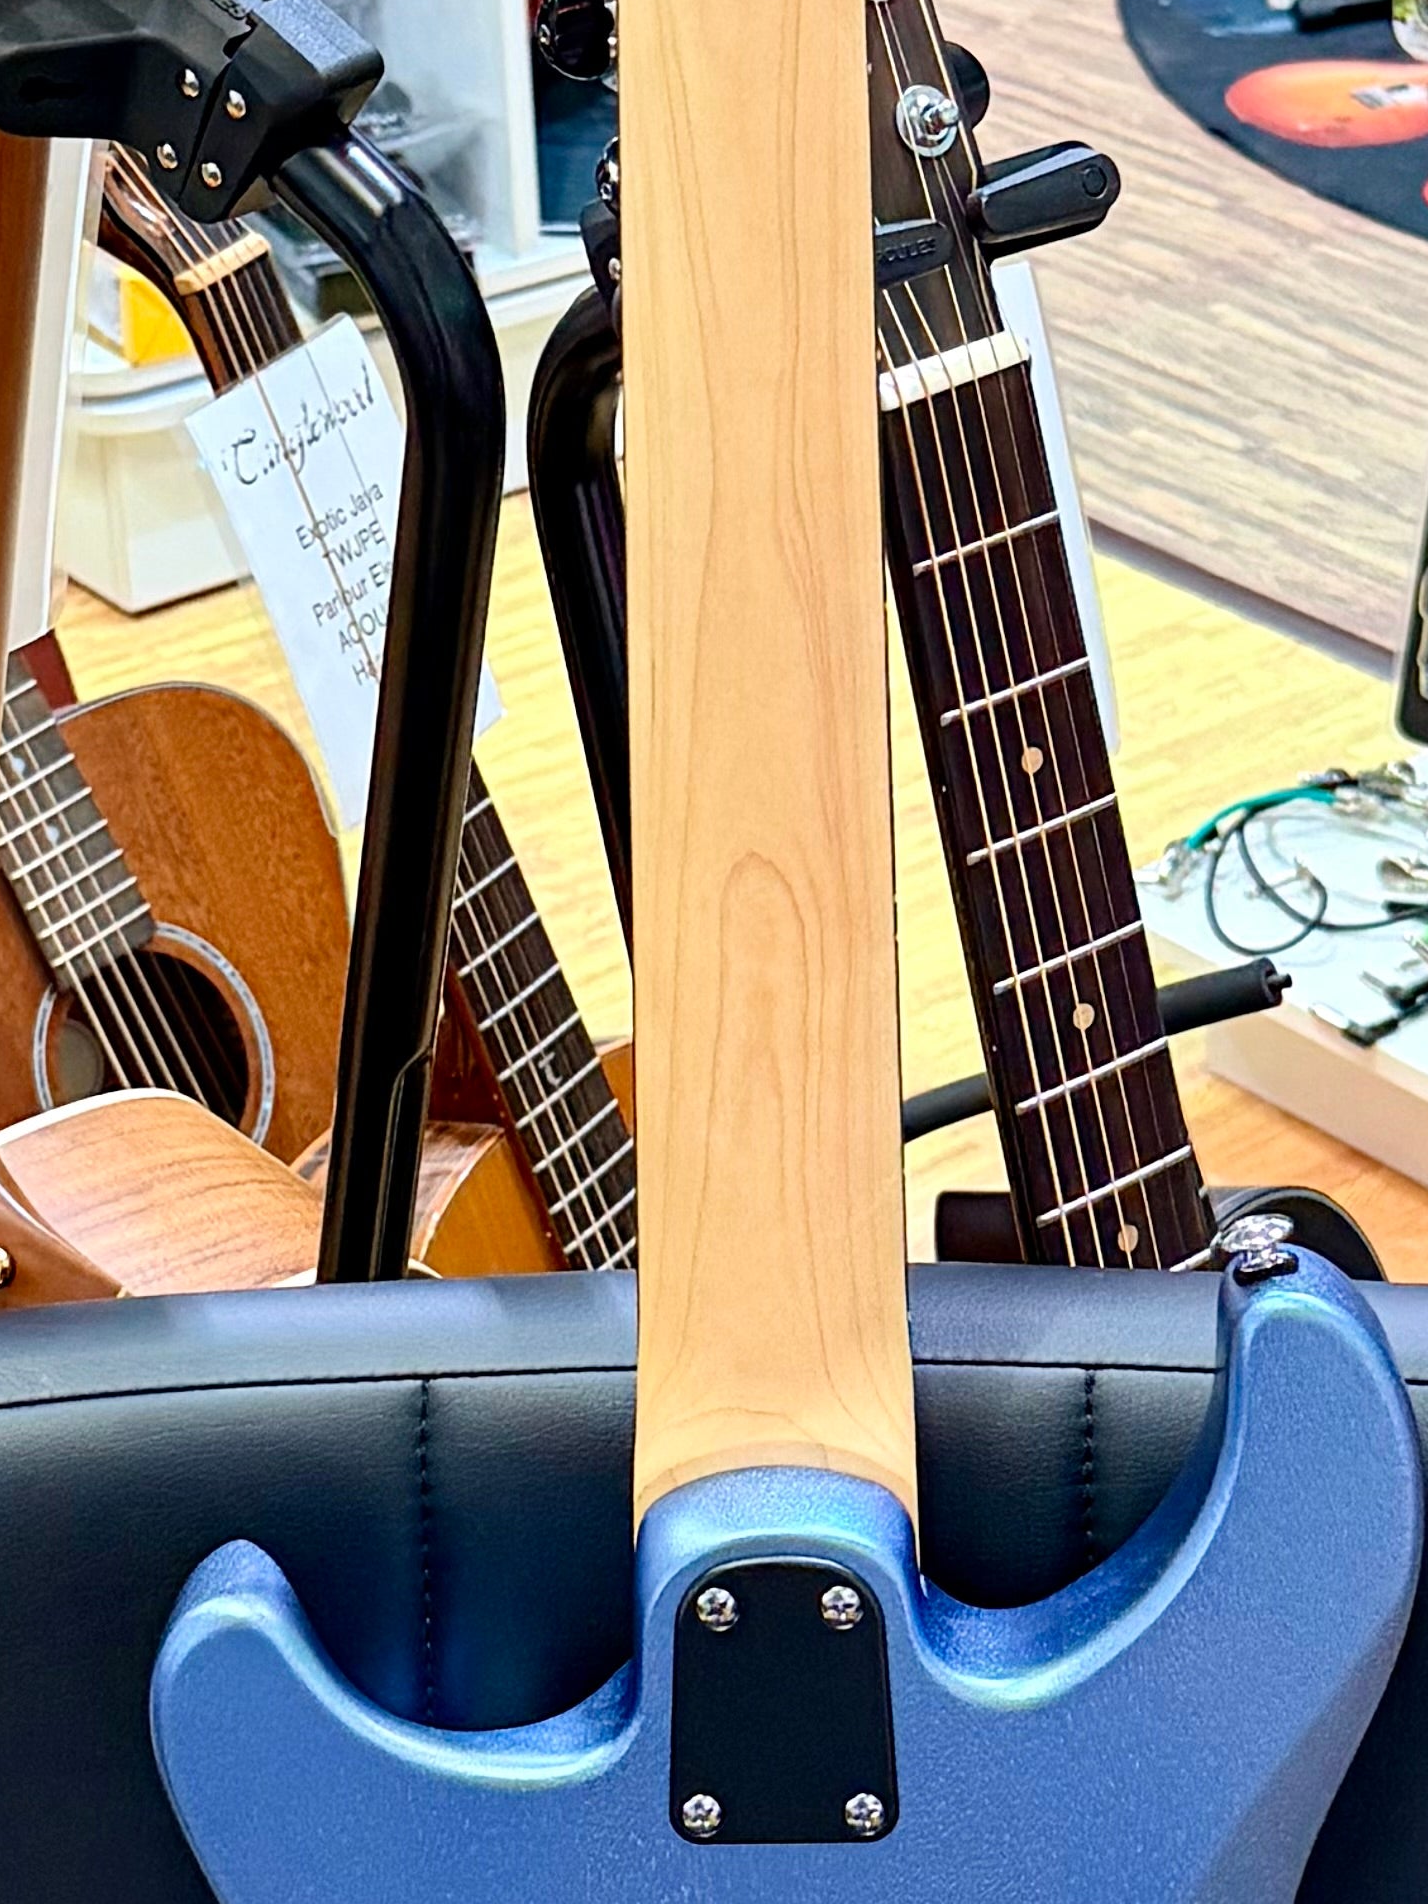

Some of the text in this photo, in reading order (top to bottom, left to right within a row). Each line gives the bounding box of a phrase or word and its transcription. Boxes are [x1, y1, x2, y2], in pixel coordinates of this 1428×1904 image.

[295, 482, 384, 550] Exotic Java
[313, 577, 369, 627] Parlour
